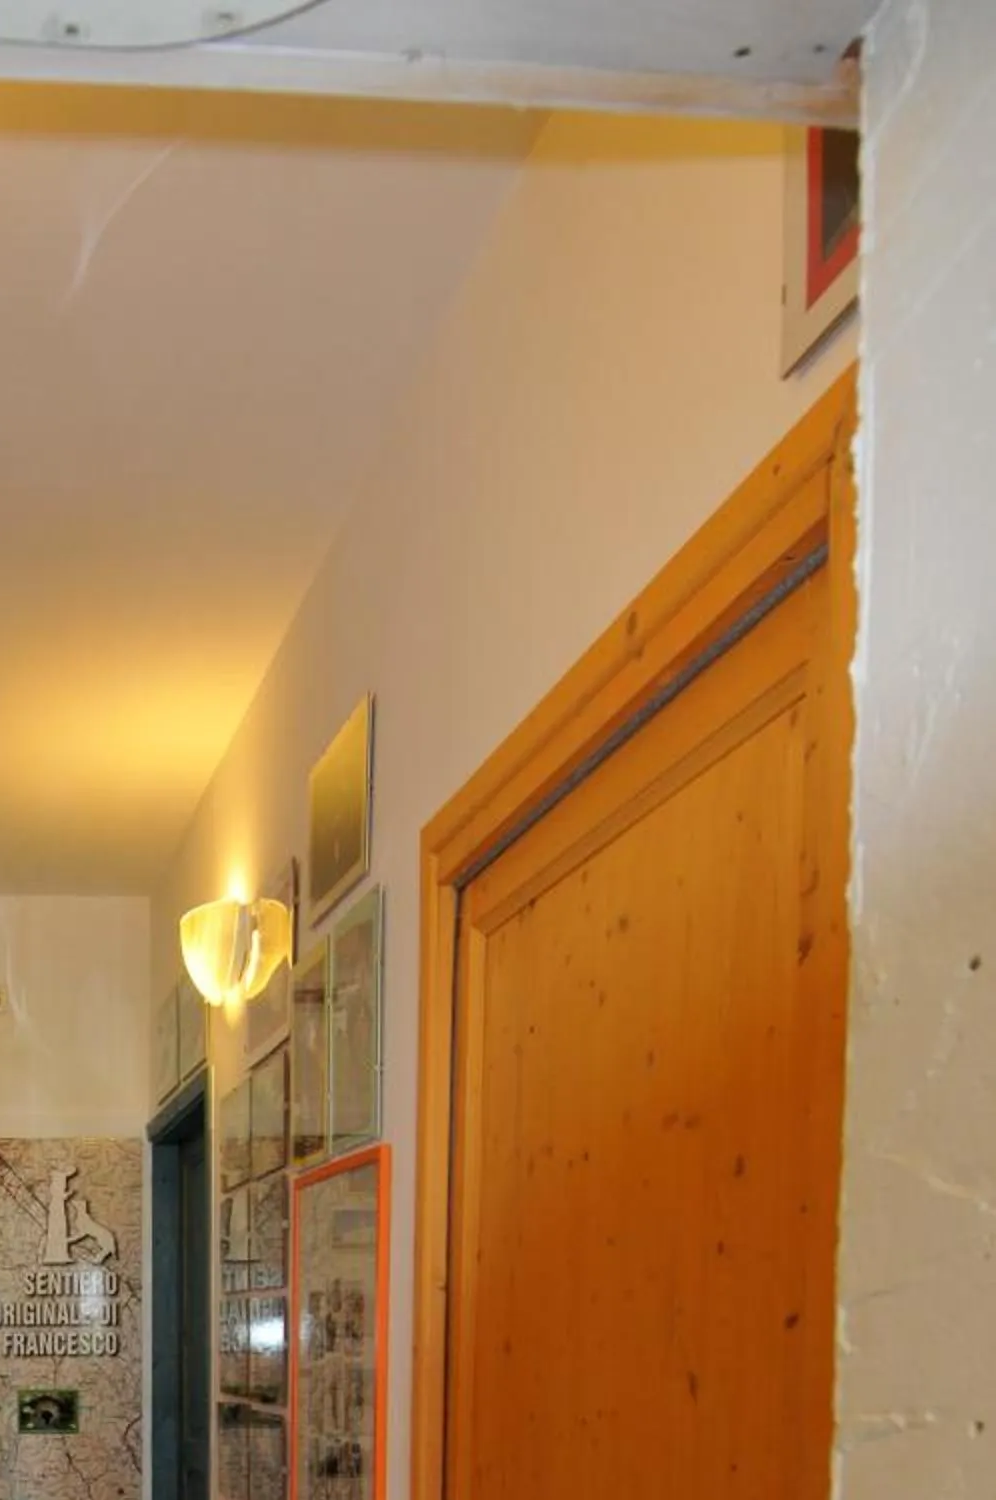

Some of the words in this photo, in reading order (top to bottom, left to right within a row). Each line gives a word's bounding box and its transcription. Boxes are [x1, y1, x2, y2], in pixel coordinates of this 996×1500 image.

[24, 1271, 118, 1295] SENTIERO
[101, 1301, 117, 1325] DI
[4, 1331, 117, 1355] FRANCESCO
